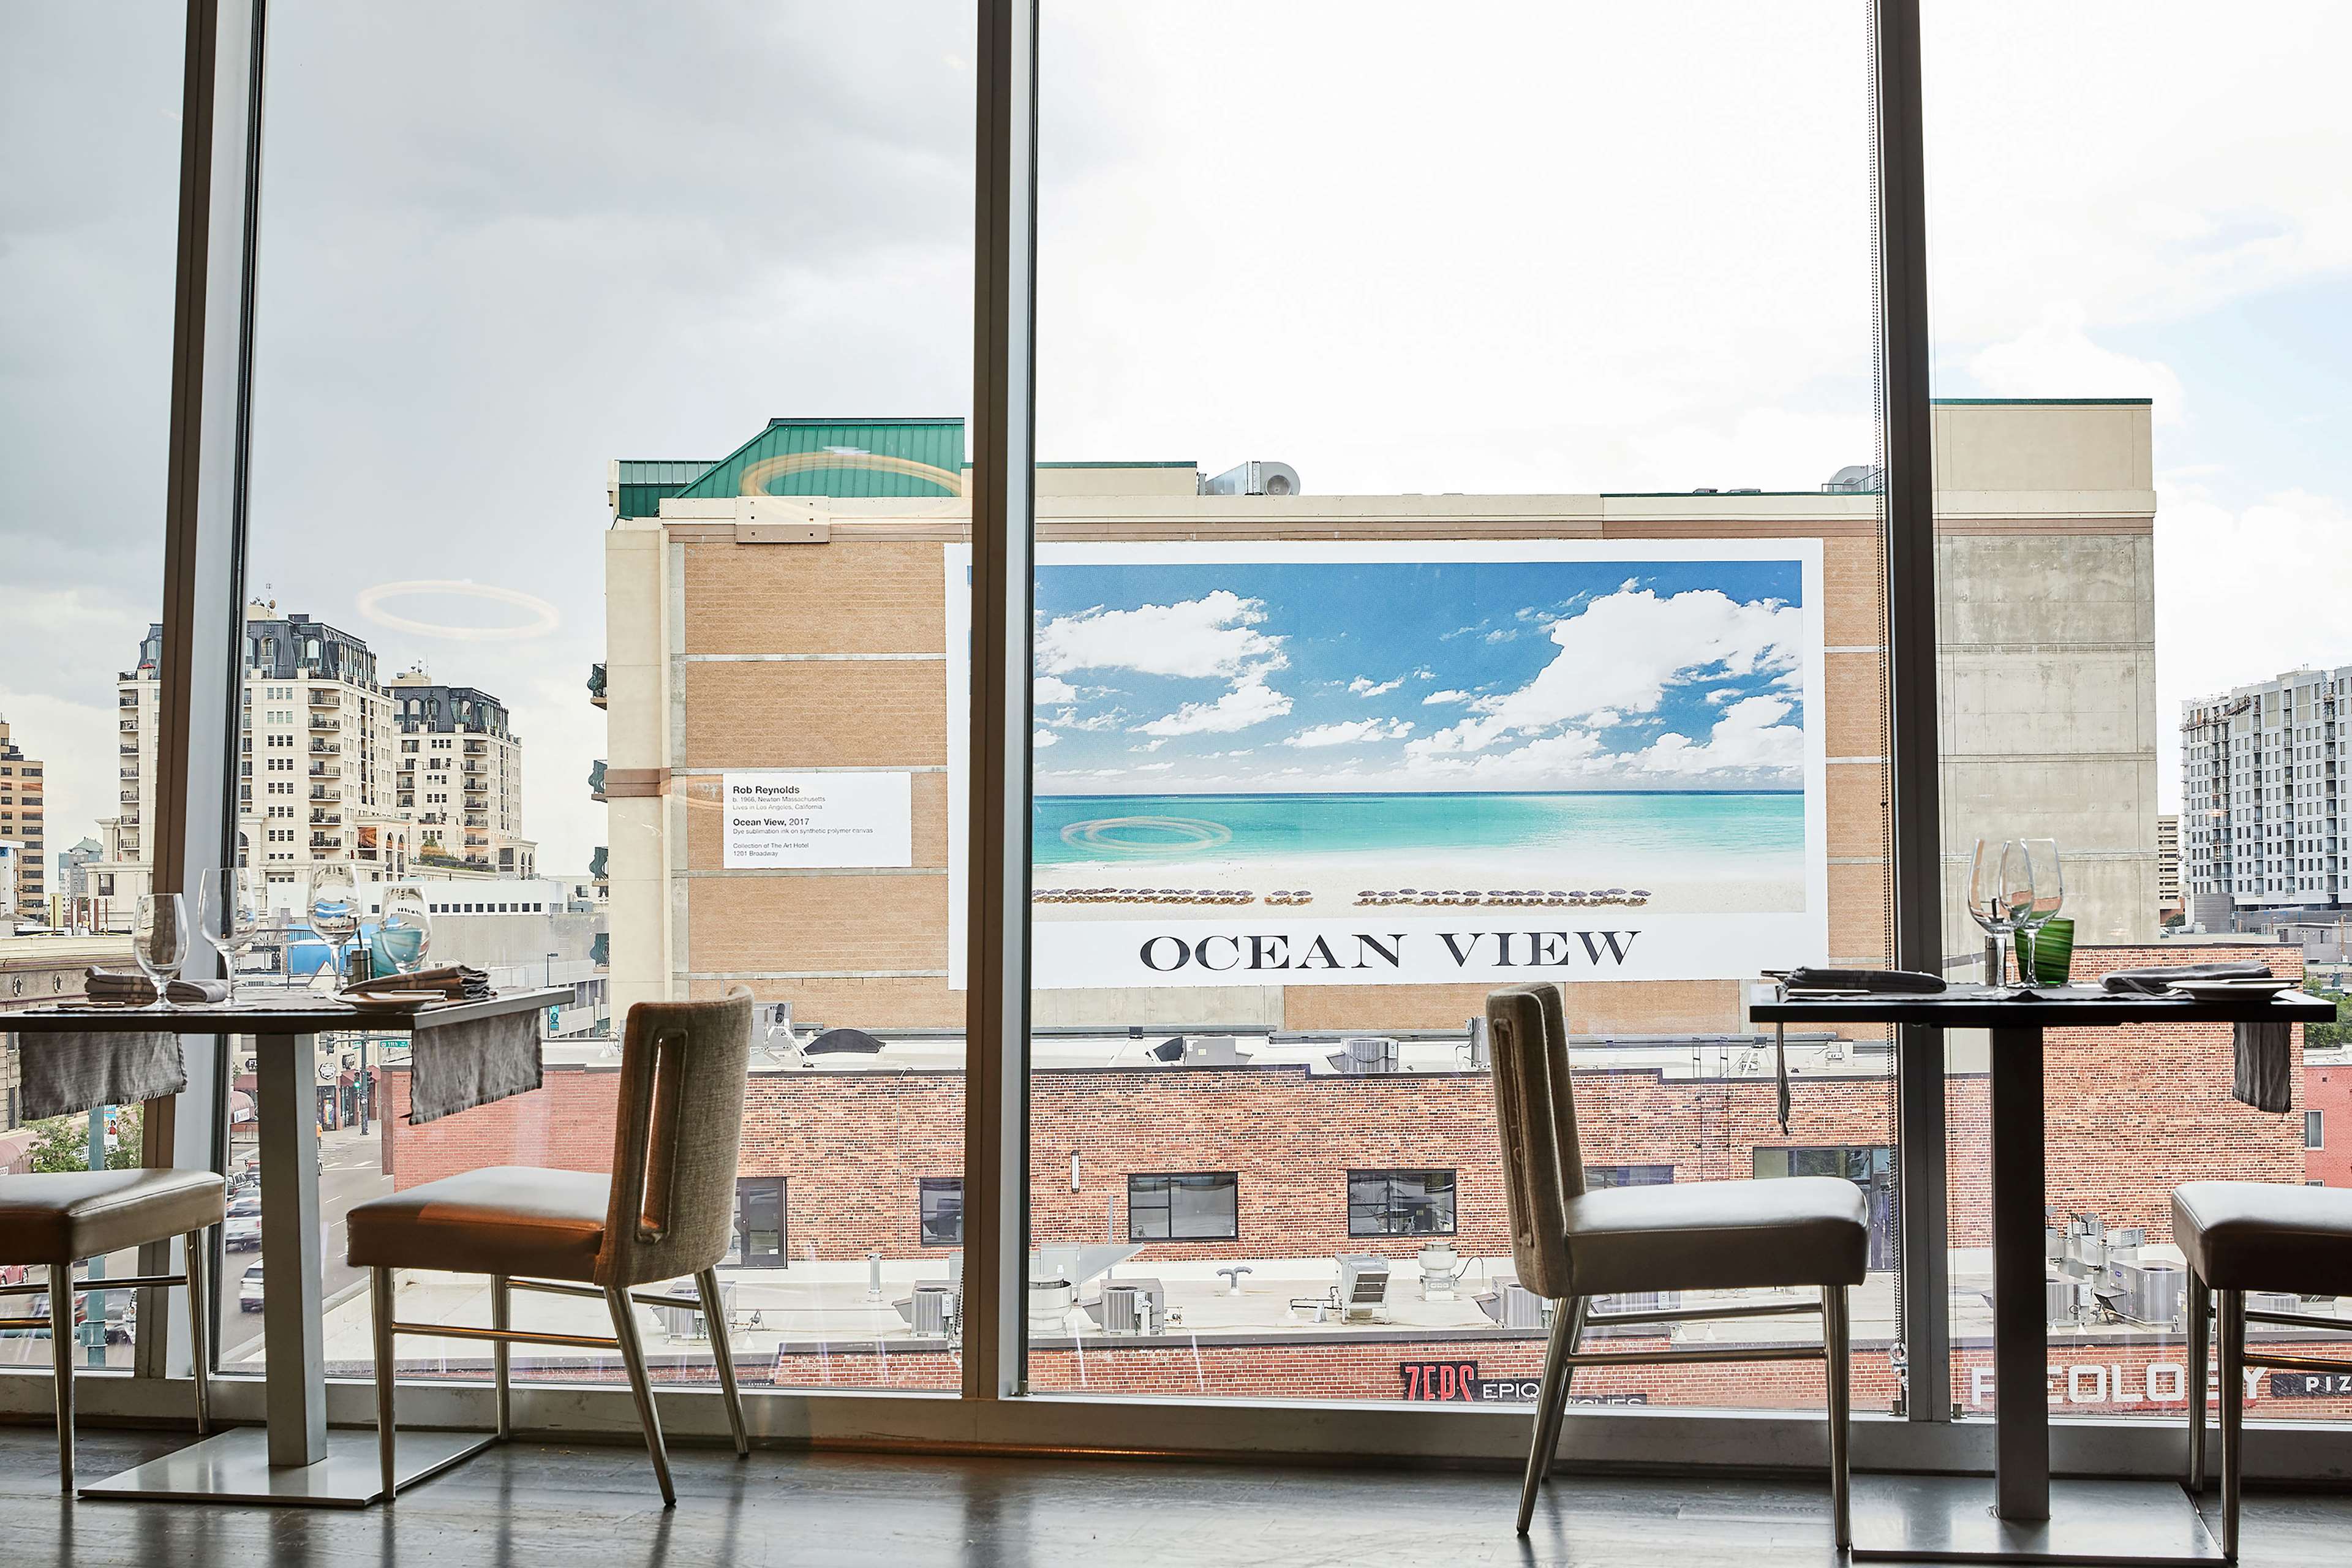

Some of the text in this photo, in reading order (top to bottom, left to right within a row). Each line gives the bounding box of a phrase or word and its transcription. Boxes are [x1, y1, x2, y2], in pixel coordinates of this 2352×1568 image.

[755, 786, 800, 796] Reynolds
[764, 818, 786, 827] View,
[1140, 930, 1642, 971] OCEAN VIEW
